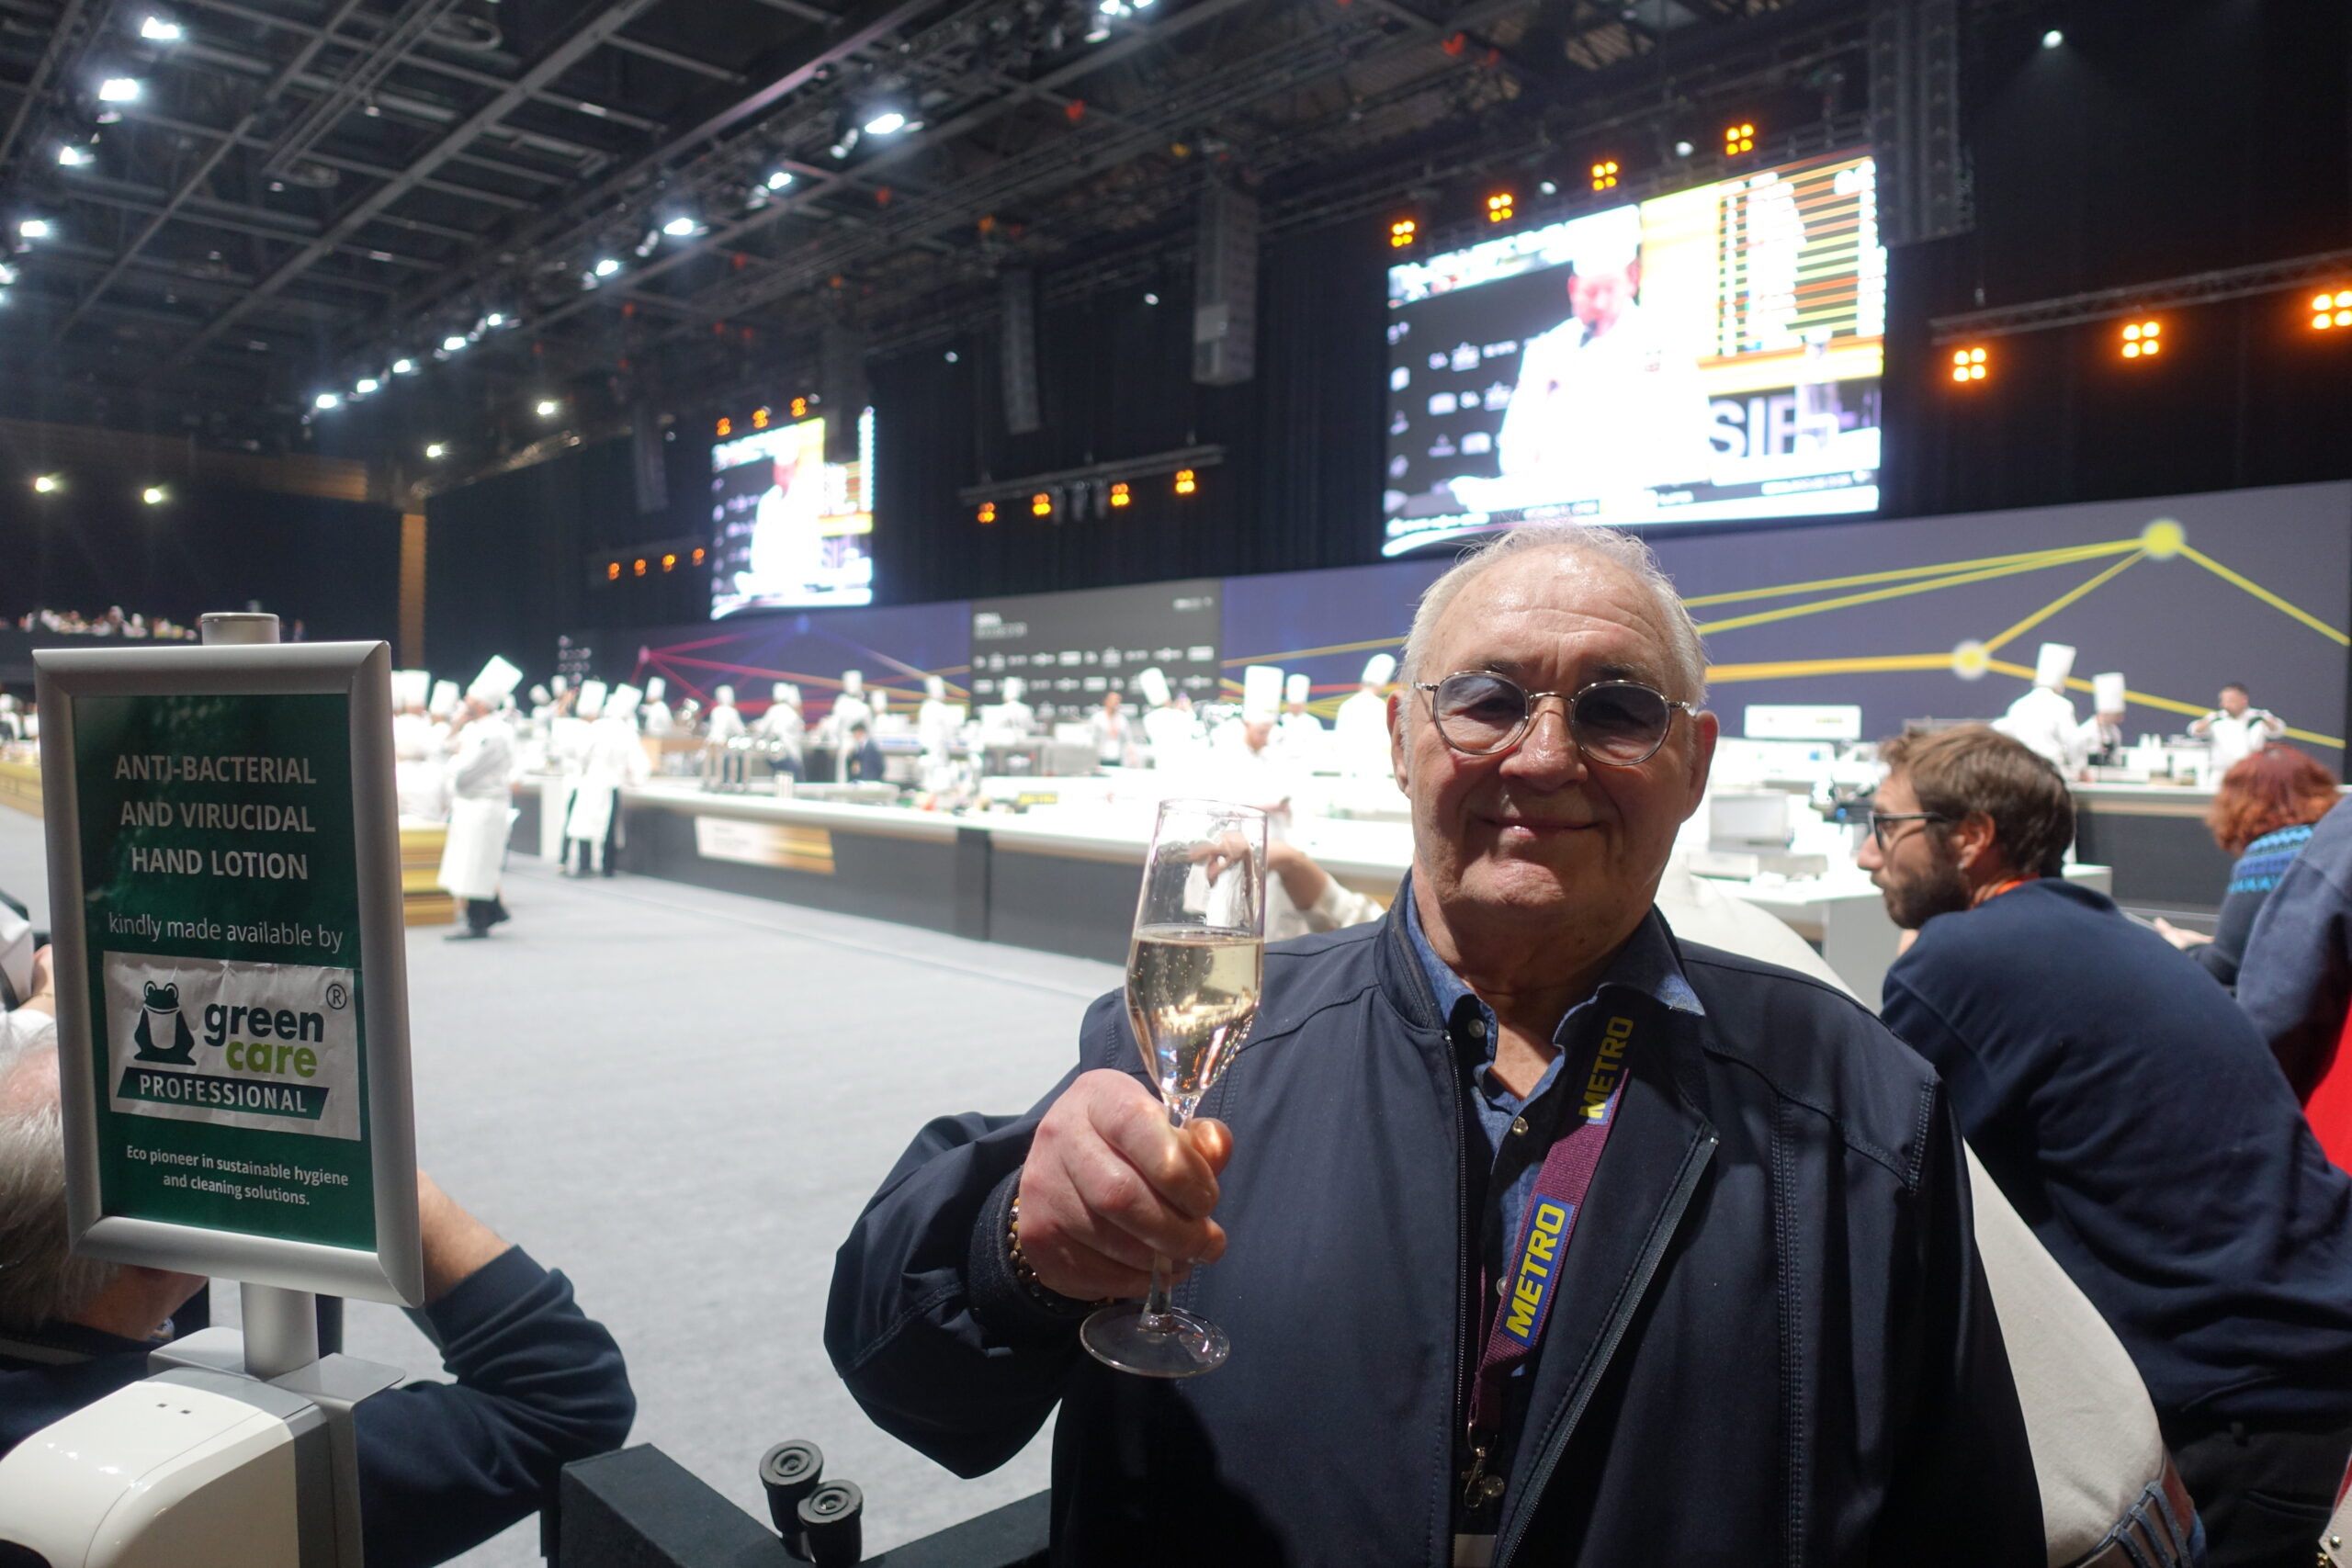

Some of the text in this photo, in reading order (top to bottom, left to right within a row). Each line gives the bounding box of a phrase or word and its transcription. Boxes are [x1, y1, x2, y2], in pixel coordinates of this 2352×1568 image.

[115, 754, 317, 784] ANTI-BACTERIAL
[120, 800, 316, 832] AND VIRUCIDAL
[131, 847, 309, 880] HAND LOTION
[108, 912, 344, 953] kindly made available by
[204, 1002, 325, 1047] green
[226, 1041, 317, 1078] care
[1578, 1015, 1634, 1120] METRO
[139, 1074, 308, 1113] PROFESSIONAL
[126, 1145, 349, 1187] Eco pioneer in sustainable hygiene
[163, 1173, 311, 1206] and cleaning solutions.
[1506, 1202, 1566, 1338] METRO
